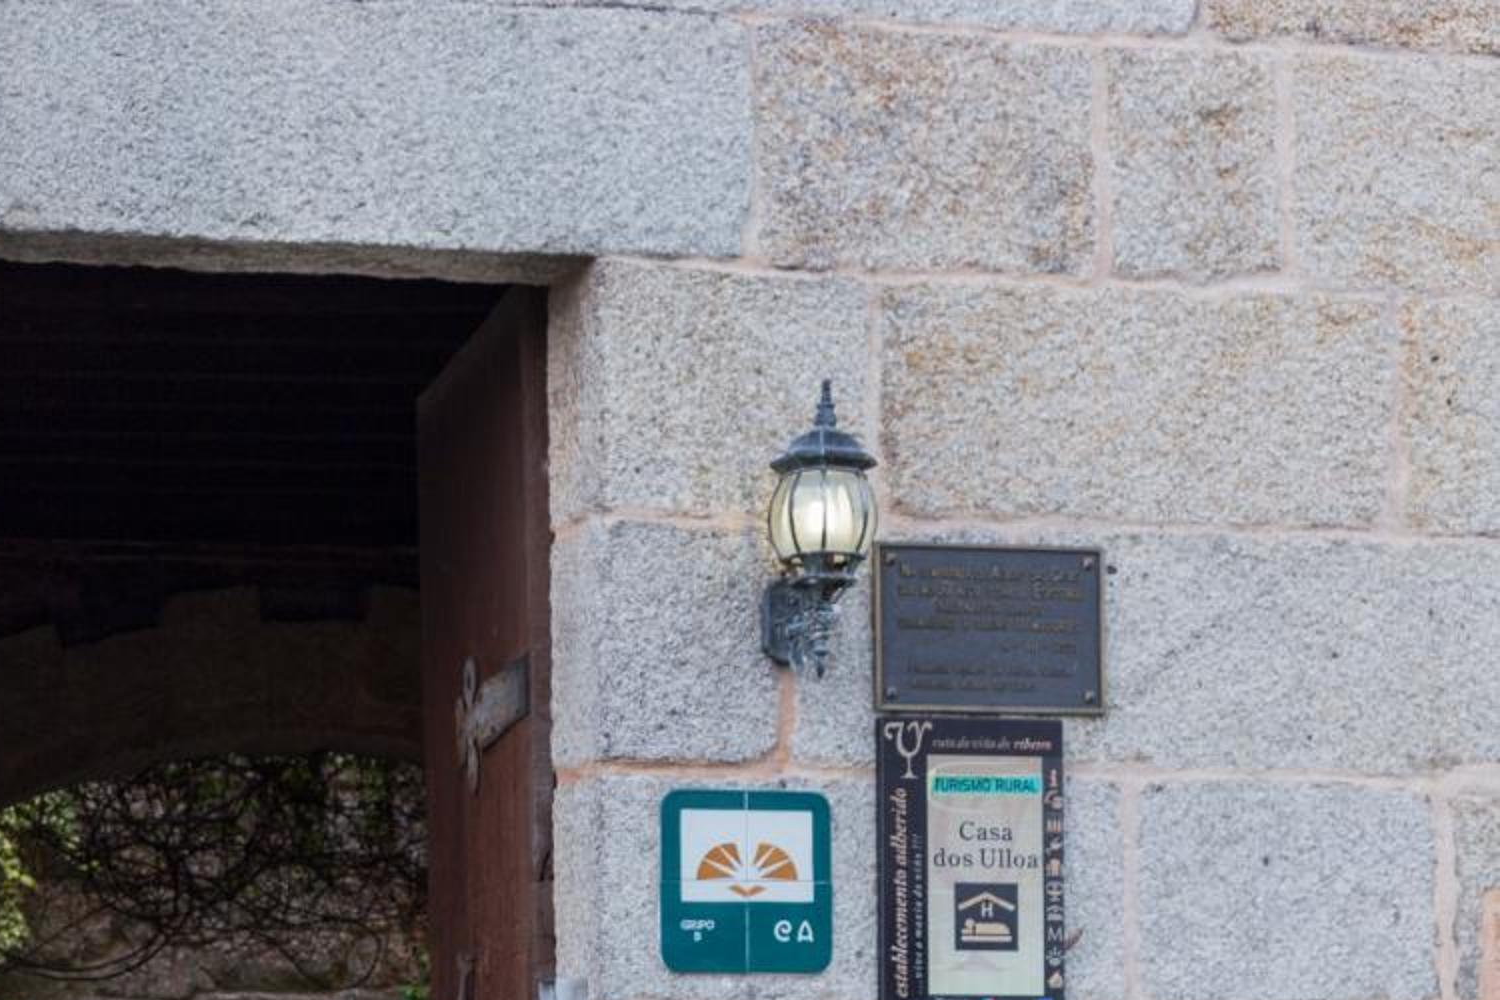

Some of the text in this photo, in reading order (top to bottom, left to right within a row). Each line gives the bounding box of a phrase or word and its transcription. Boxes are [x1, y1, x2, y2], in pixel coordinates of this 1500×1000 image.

[933, 776, 1038, 793] TURISMO RURAL
[958, 820, 1013, 842] Casa
[932, 847, 1039, 869] dos Ulloa
[980, 902, 993, 918] H
